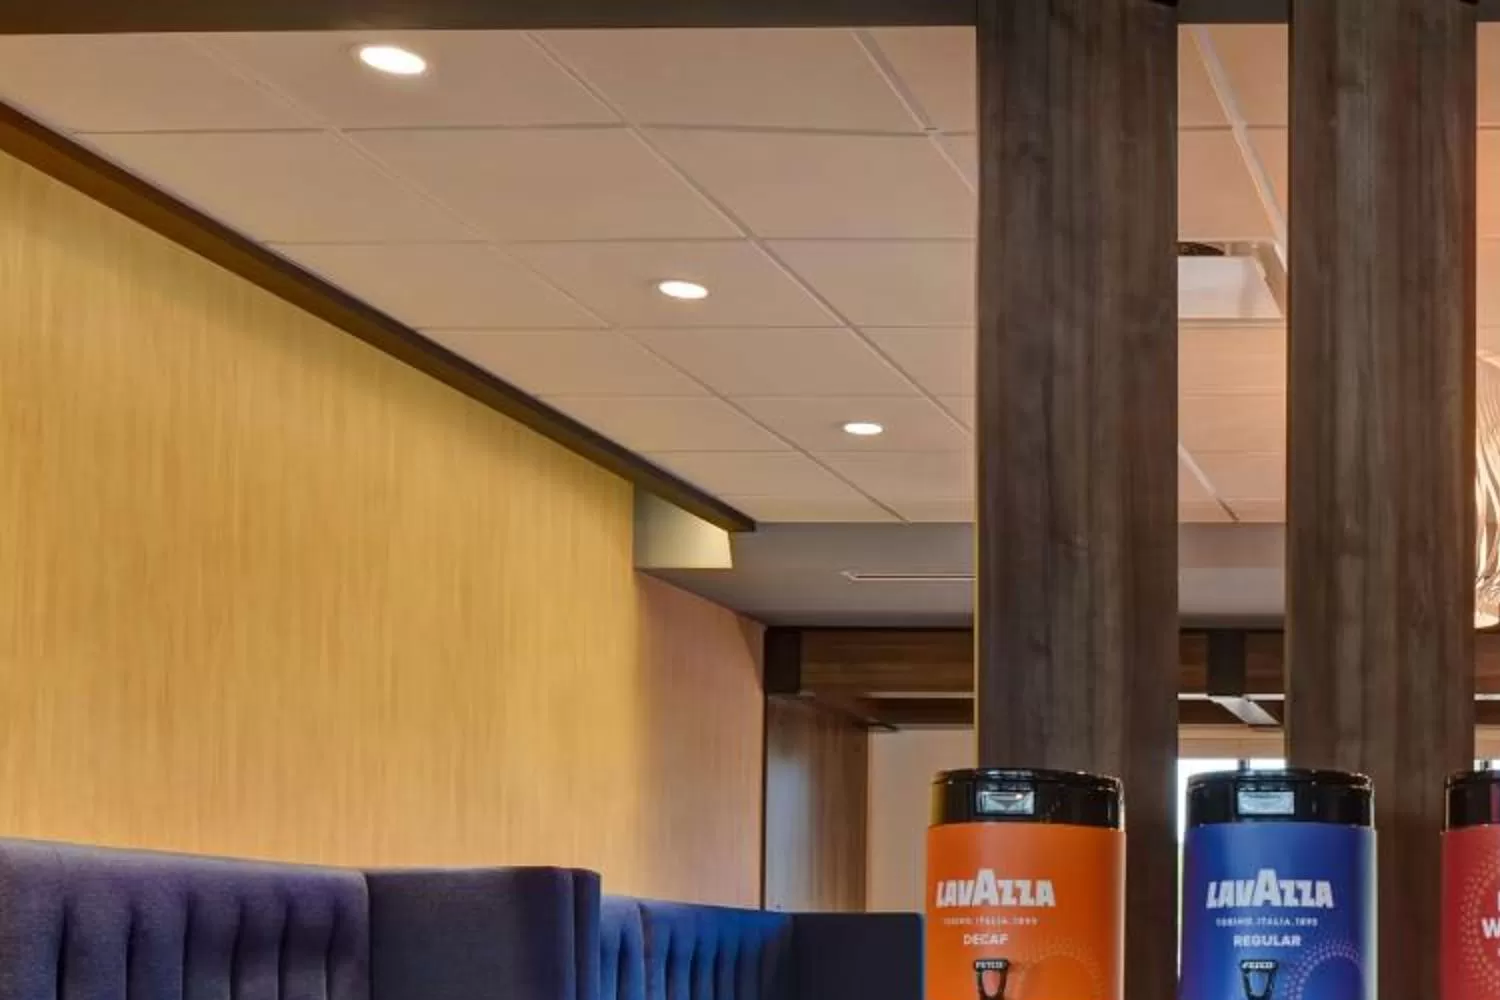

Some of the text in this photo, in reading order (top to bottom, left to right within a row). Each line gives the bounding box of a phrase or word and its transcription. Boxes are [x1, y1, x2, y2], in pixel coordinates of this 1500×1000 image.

[936, 867, 1056, 908] LAVAZZA
[1205, 868, 1334, 909] LAVAZZA
[963, 933, 1008, 945] DECAF
[1233, 934, 1302, 947] REGULAR
